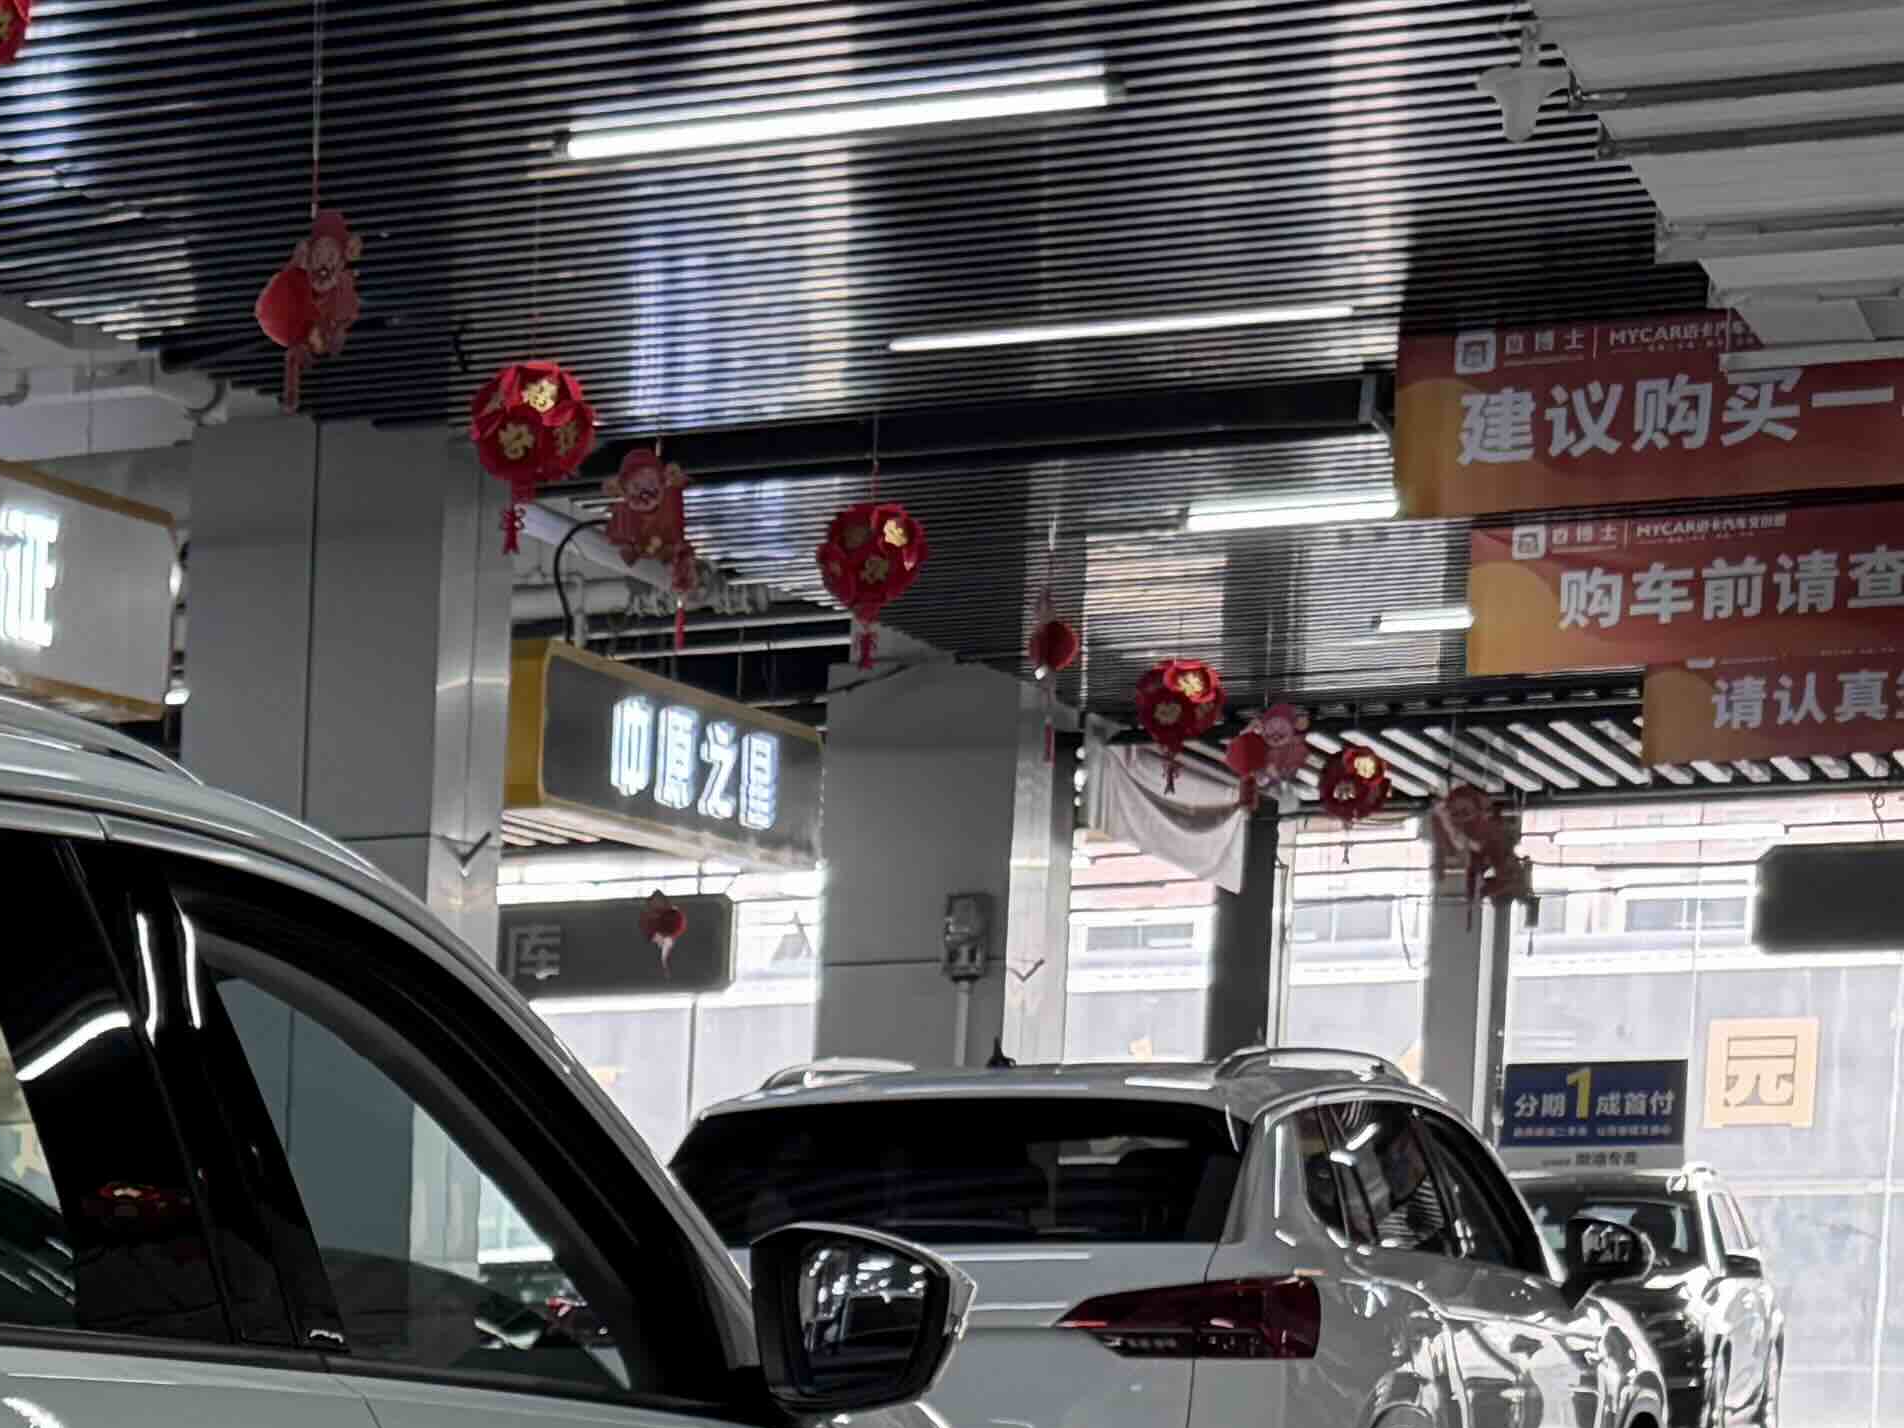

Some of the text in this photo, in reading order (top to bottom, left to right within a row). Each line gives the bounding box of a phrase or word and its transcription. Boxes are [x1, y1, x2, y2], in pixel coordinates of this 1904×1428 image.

[1559, 545, 1904, 631] 购车前请查
[1711, 668, 1904, 730] 请认真
